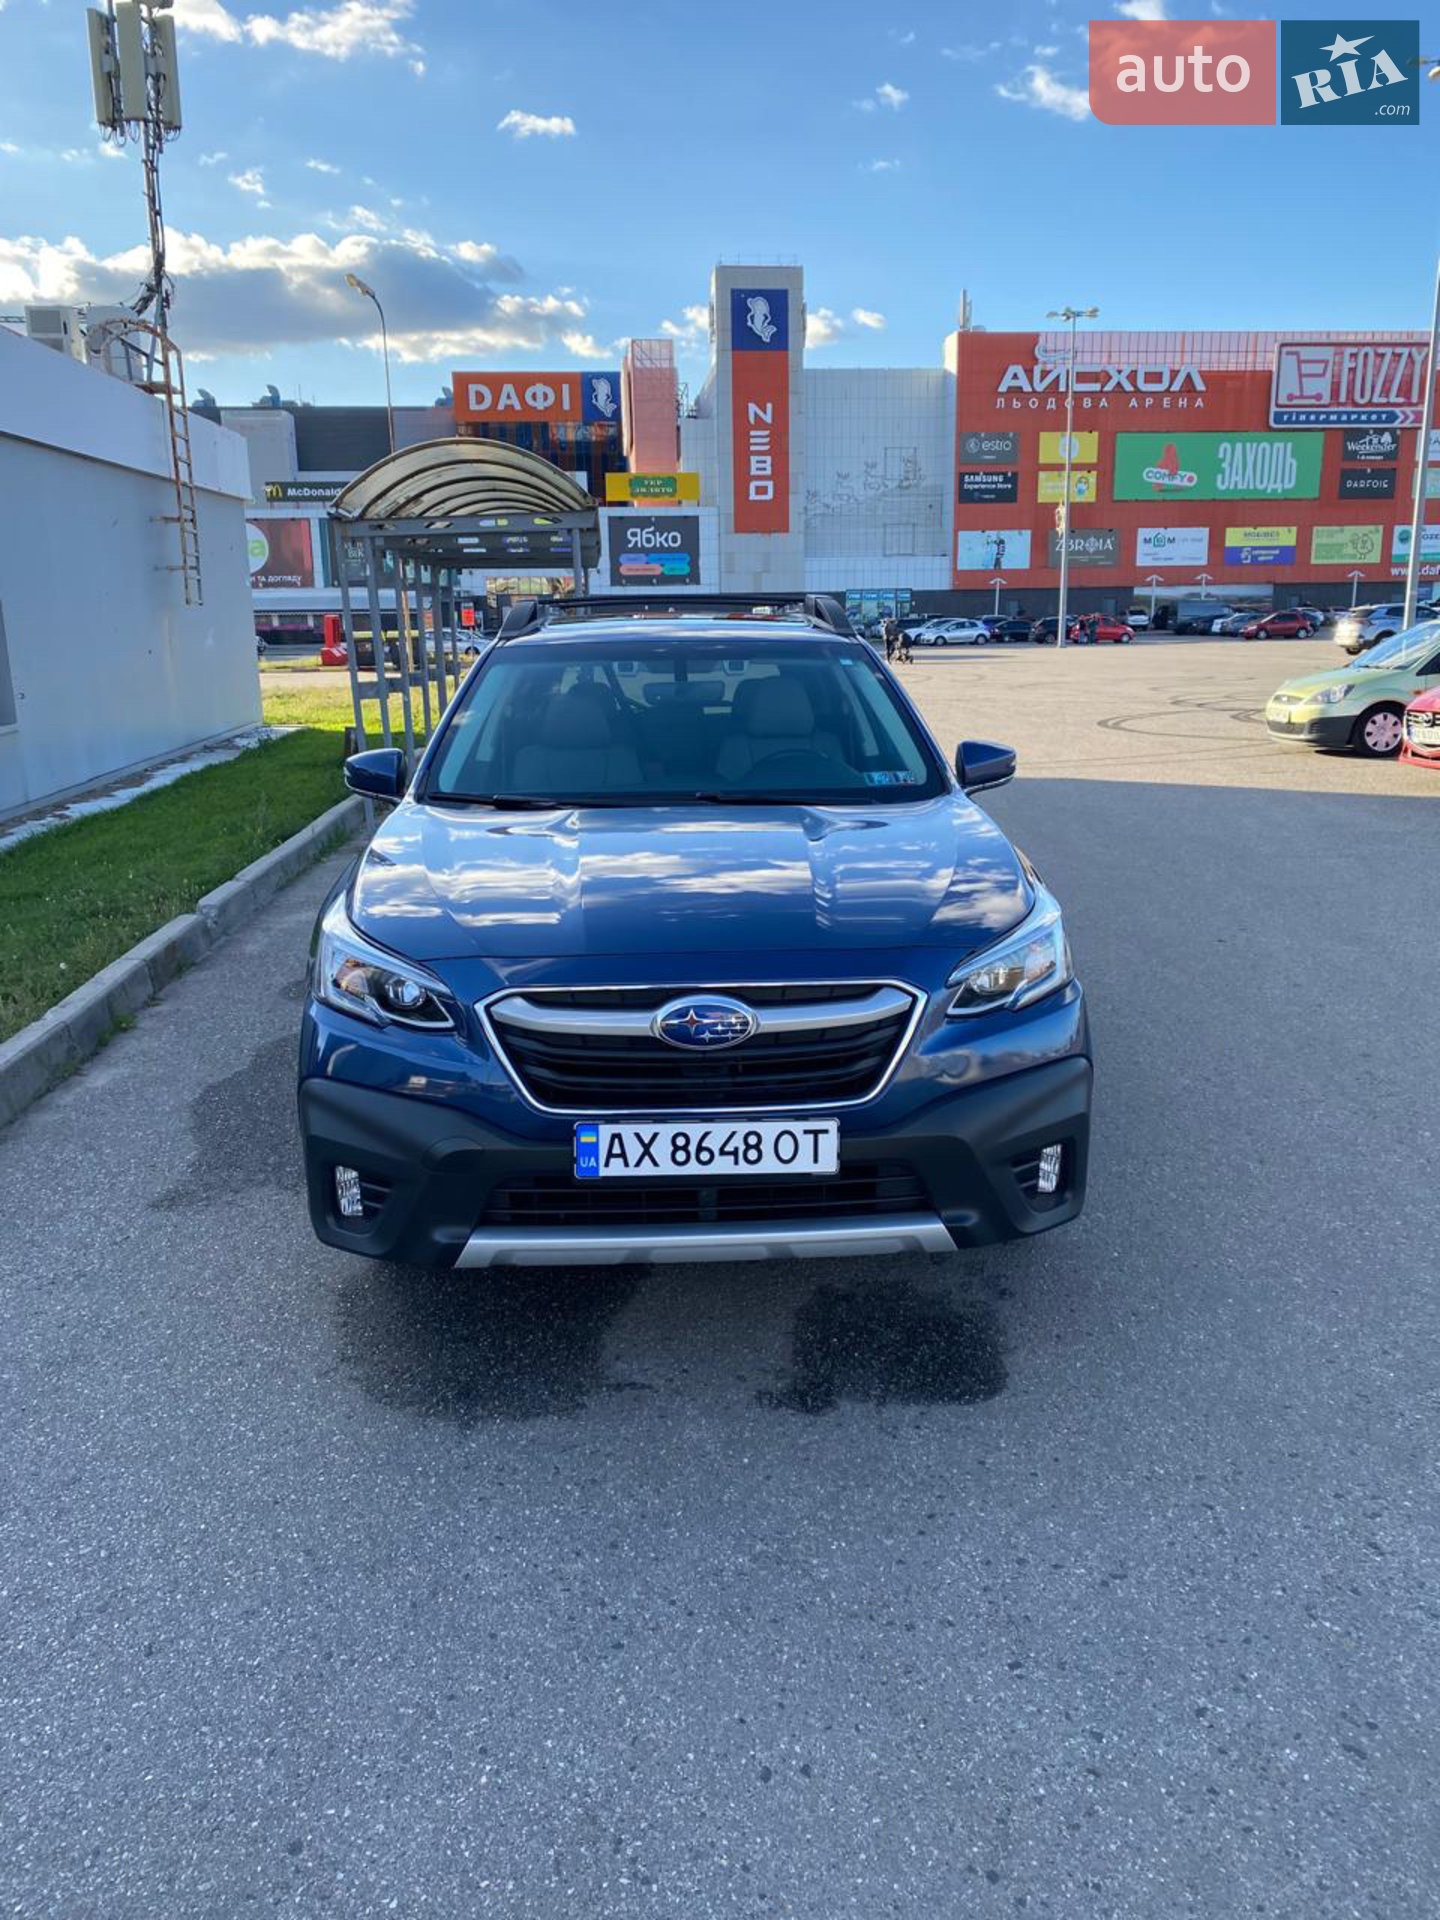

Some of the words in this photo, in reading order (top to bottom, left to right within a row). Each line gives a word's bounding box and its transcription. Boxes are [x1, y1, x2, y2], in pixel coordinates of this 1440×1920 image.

[1338, 346, 1430, 405] FOZZY
[996, 397, 1109, 410] ЛЬОДОВА
[1128, 397, 1205, 409] АРЕНА
[747, 401, 774, 501] NEBO
[963, 474, 1005, 483] SAMSUNG
[1145, 469, 1187, 484] COMFY
[1216, 441, 1298, 494] ЗАХОДЬ
[626, 525, 682, 549] Ябко
[603, 1132, 661, 1168] AX
[670, 1130, 763, 1167] 8648
[773, 1129, 830, 1165] OT
[580, 1156, 597, 1169] UA
